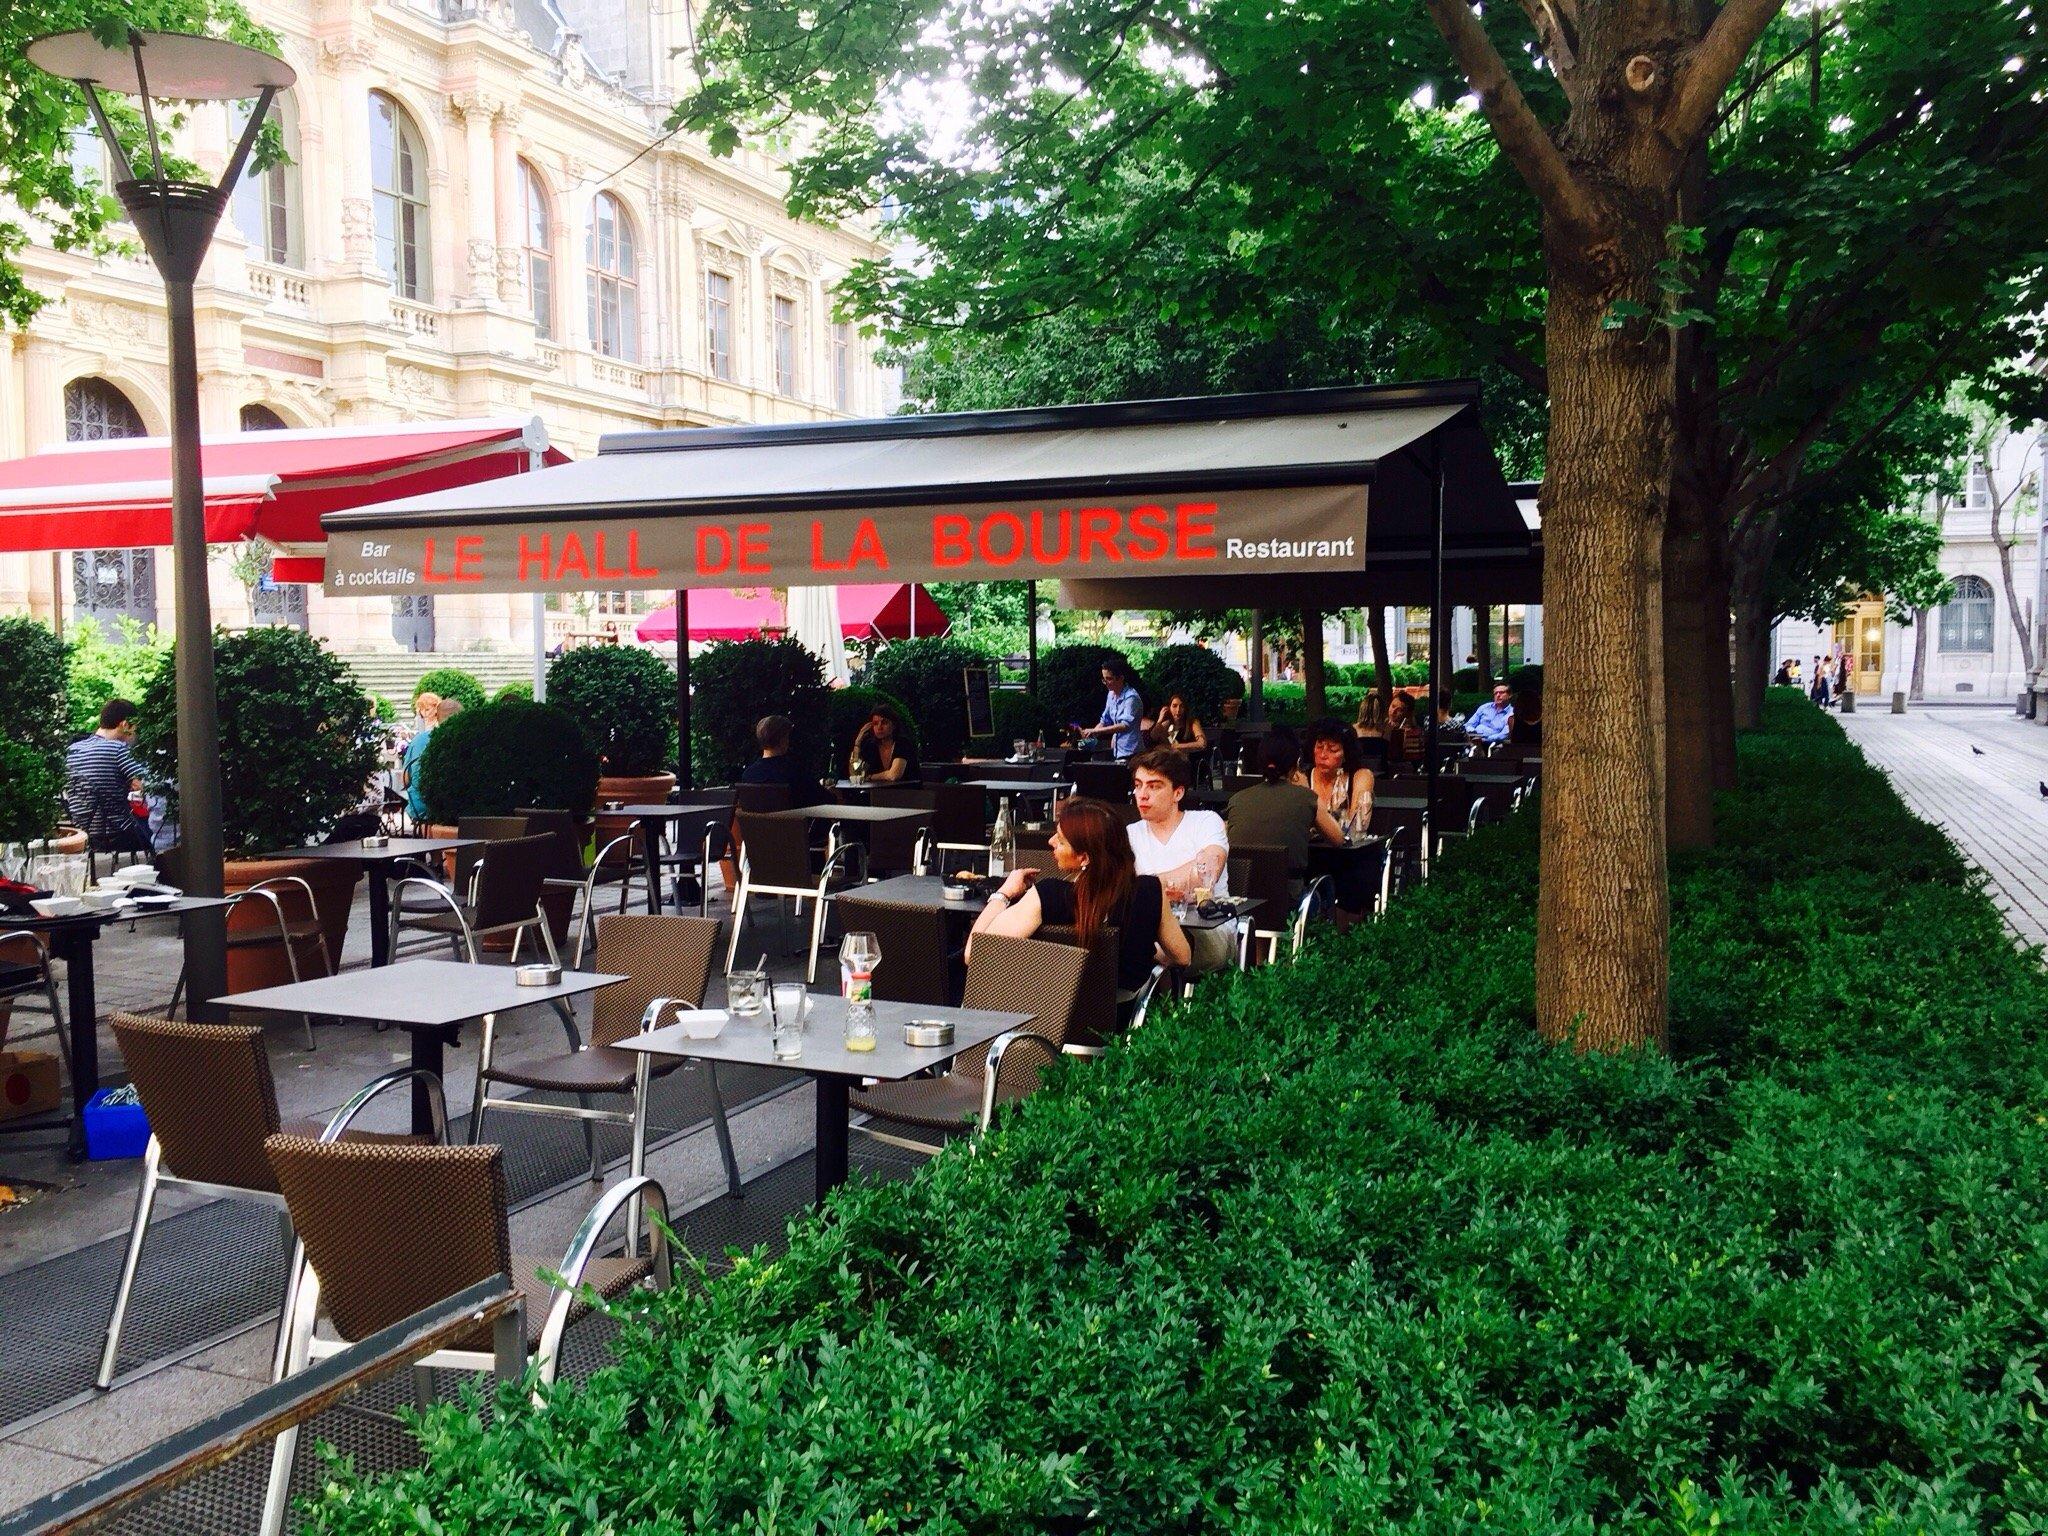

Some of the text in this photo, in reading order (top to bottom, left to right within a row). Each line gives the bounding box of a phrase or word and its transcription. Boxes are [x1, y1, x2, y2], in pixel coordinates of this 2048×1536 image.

[360, 541, 391, 558] Bar
[423, 503, 1218, 583] LE HALL DE LA BOURSE
[1226, 536, 1355, 559] Restaurant
[334, 567, 416, 587] à cocktails
